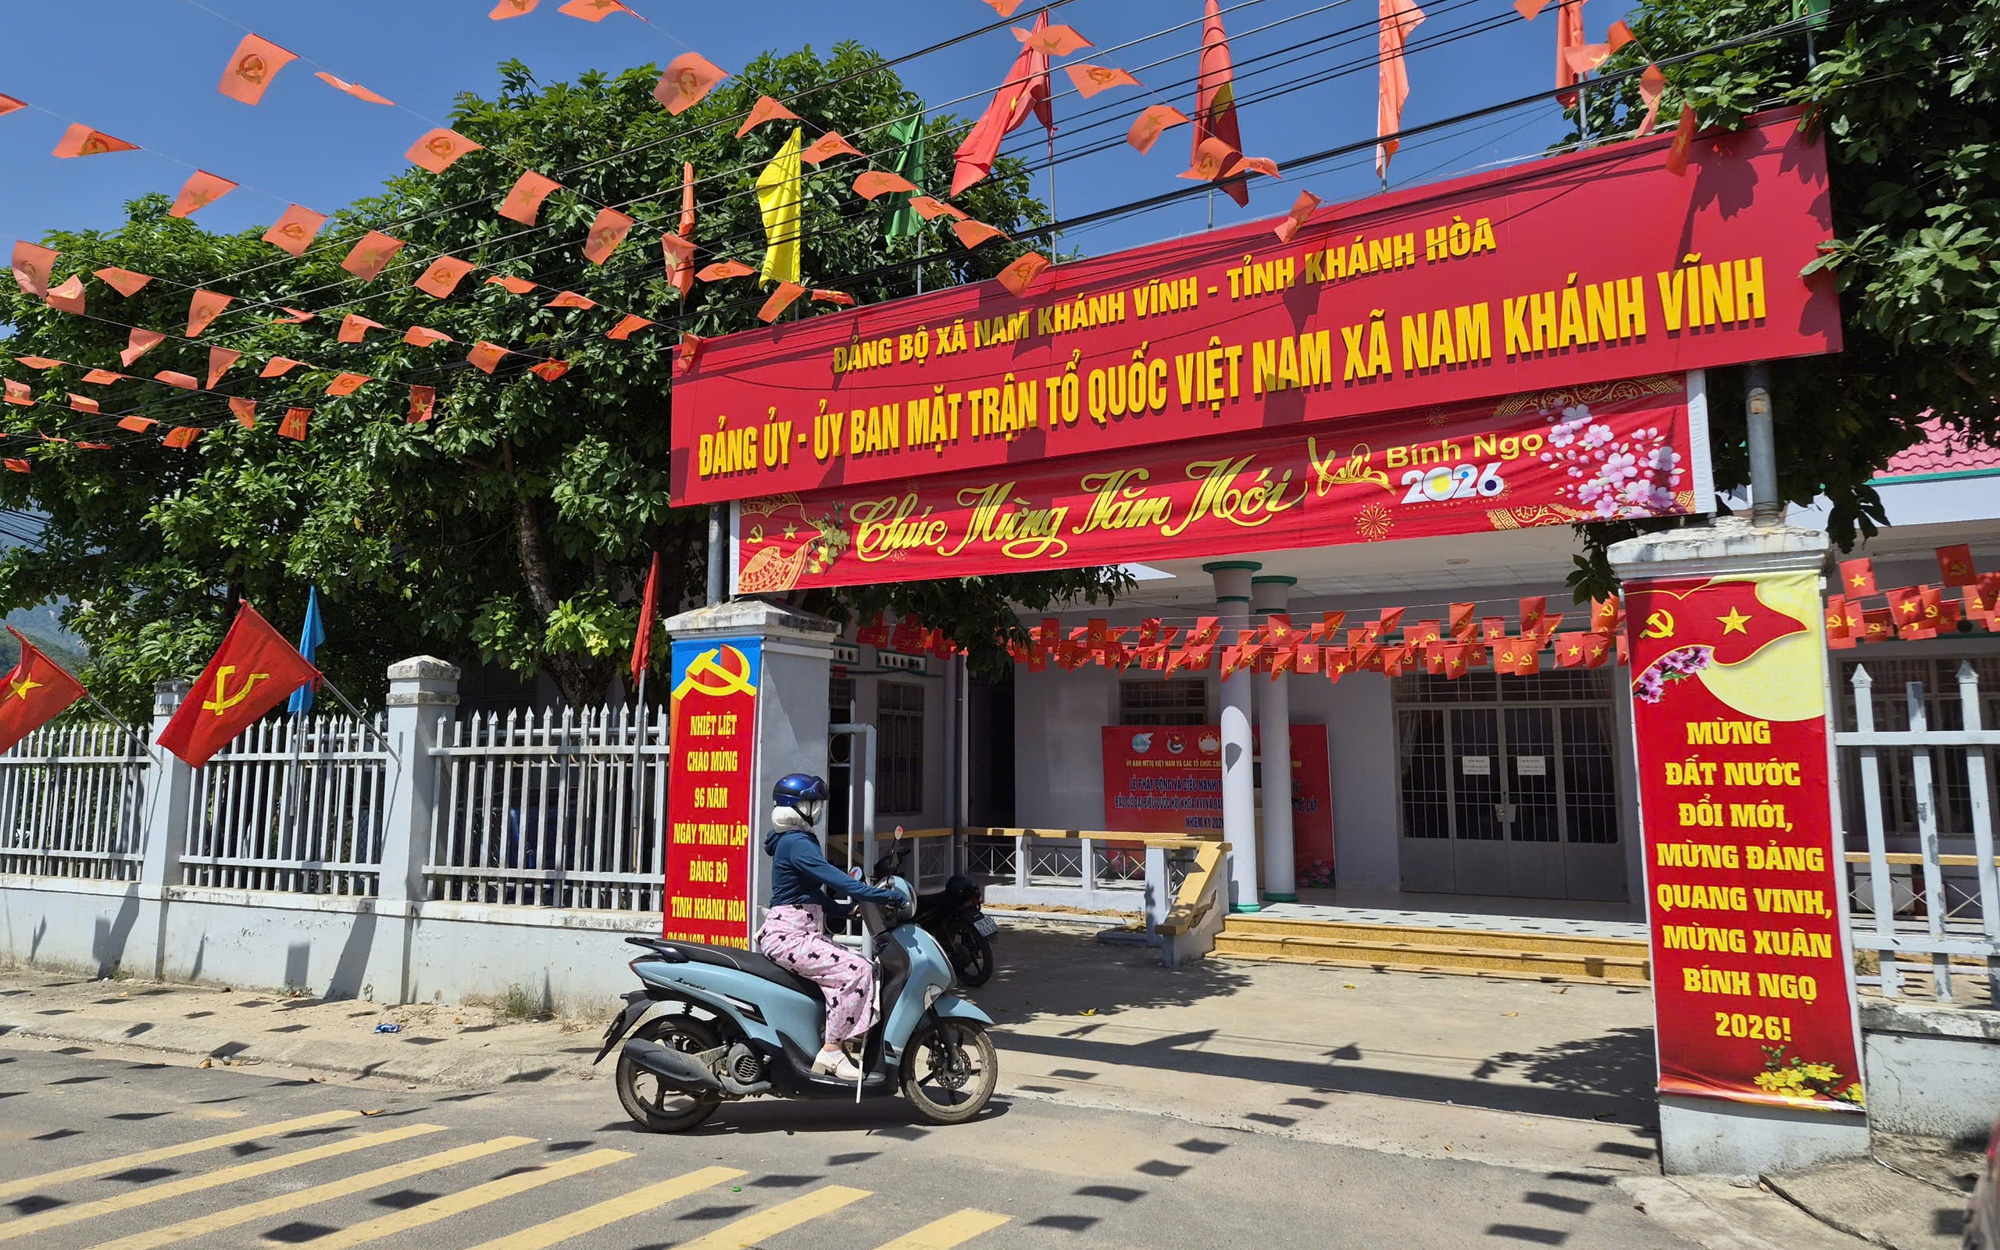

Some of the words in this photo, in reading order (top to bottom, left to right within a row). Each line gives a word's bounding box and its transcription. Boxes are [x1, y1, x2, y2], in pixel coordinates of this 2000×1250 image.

[834, 336, 892, 373] ĐẢNG
[899, 326, 929, 364] BỘ
[936, 319, 967, 355] XÃ
[974, 311, 1029, 348] NAM
[1038, 292, 1125, 335] KHÁNH
[1133, 277, 1198, 316] VĨNH
[1227, 255, 1295, 298] TỈNH
[1305, 233, 1415, 284] KHÁNH
[1426, 216, 1496, 261] HÒA
[699, 416, 757, 476] ĐẢNG
[764, 407, 792, 467] ỦY
[814, 399, 843, 459] ỦY
[851, 404, 900, 454] BAN
[908, 385, 962, 452] MẶT
[968, 373, 1037, 441] TRẬN
[1046, 349, 1080, 424] TỔ
[1088, 341, 1167, 423] QUỐC
[1176, 336, 1243, 411] VIỆT
[1253, 330, 1331, 394] NAM
[1342, 310, 1392, 381] XÃ
[1402, 303, 1491, 370] NAM
[1503, 273, 1646, 355] KHÁNH
[1658, 253, 1766, 331] VĨNH
[1387, 440, 1461, 468] Bính
[1474, 434, 1543, 460] Ngọ
[1401, 462, 1504, 504] 2026
[850, 494, 948, 562] Chúc
[938, 481, 1068, 558] Mừng
[1072, 468, 1173, 534] Năm
[1161, 454, 1308, 537] Mới
[690, 711, 716, 739] NHIỆT
[718, 711, 737, 739] LIỆT
[1687, 717, 1771, 744] MỪNG
[687, 747, 709, 772] CHÀO
[710, 747, 738, 772] MỪNG
[1666, 755, 1717, 785] ĐẤT
[1724, 758, 1800, 786] NƯỚC
[694, 787, 705, 808] 96
[706, 783, 728, 808] NĂM
[1679, 794, 1723, 826] ĐỔI
[1730, 800, 1793, 832] MỚI,
[673, 820, 697, 845] NGÀY
[698, 820, 728, 846] THÀNH
[730, 820, 748, 850] LẬP
[689, 854, 714, 883] ĐẢNG
[716, 858, 728, 888] BỘ
[1657, 840, 1739, 869] MỪNG
[1746, 840, 1824, 871] ĐẢNG
[671, 890, 692, 919] TỈNH
[694, 894, 725, 920] KHÁNH
[727, 896, 746, 922] HÒA
[1658, 884, 1747, 911] QUANG
[1754, 888, 1832, 919] VINH,
[1663, 923, 1747, 953] MỪNG
[1753, 928, 1832, 958] XUÂN
[1683, 965, 1751, 996] BÍNH
[1758, 973, 1817, 1005] NGỌ
[1716, 1012, 1792, 1042] 2026!
